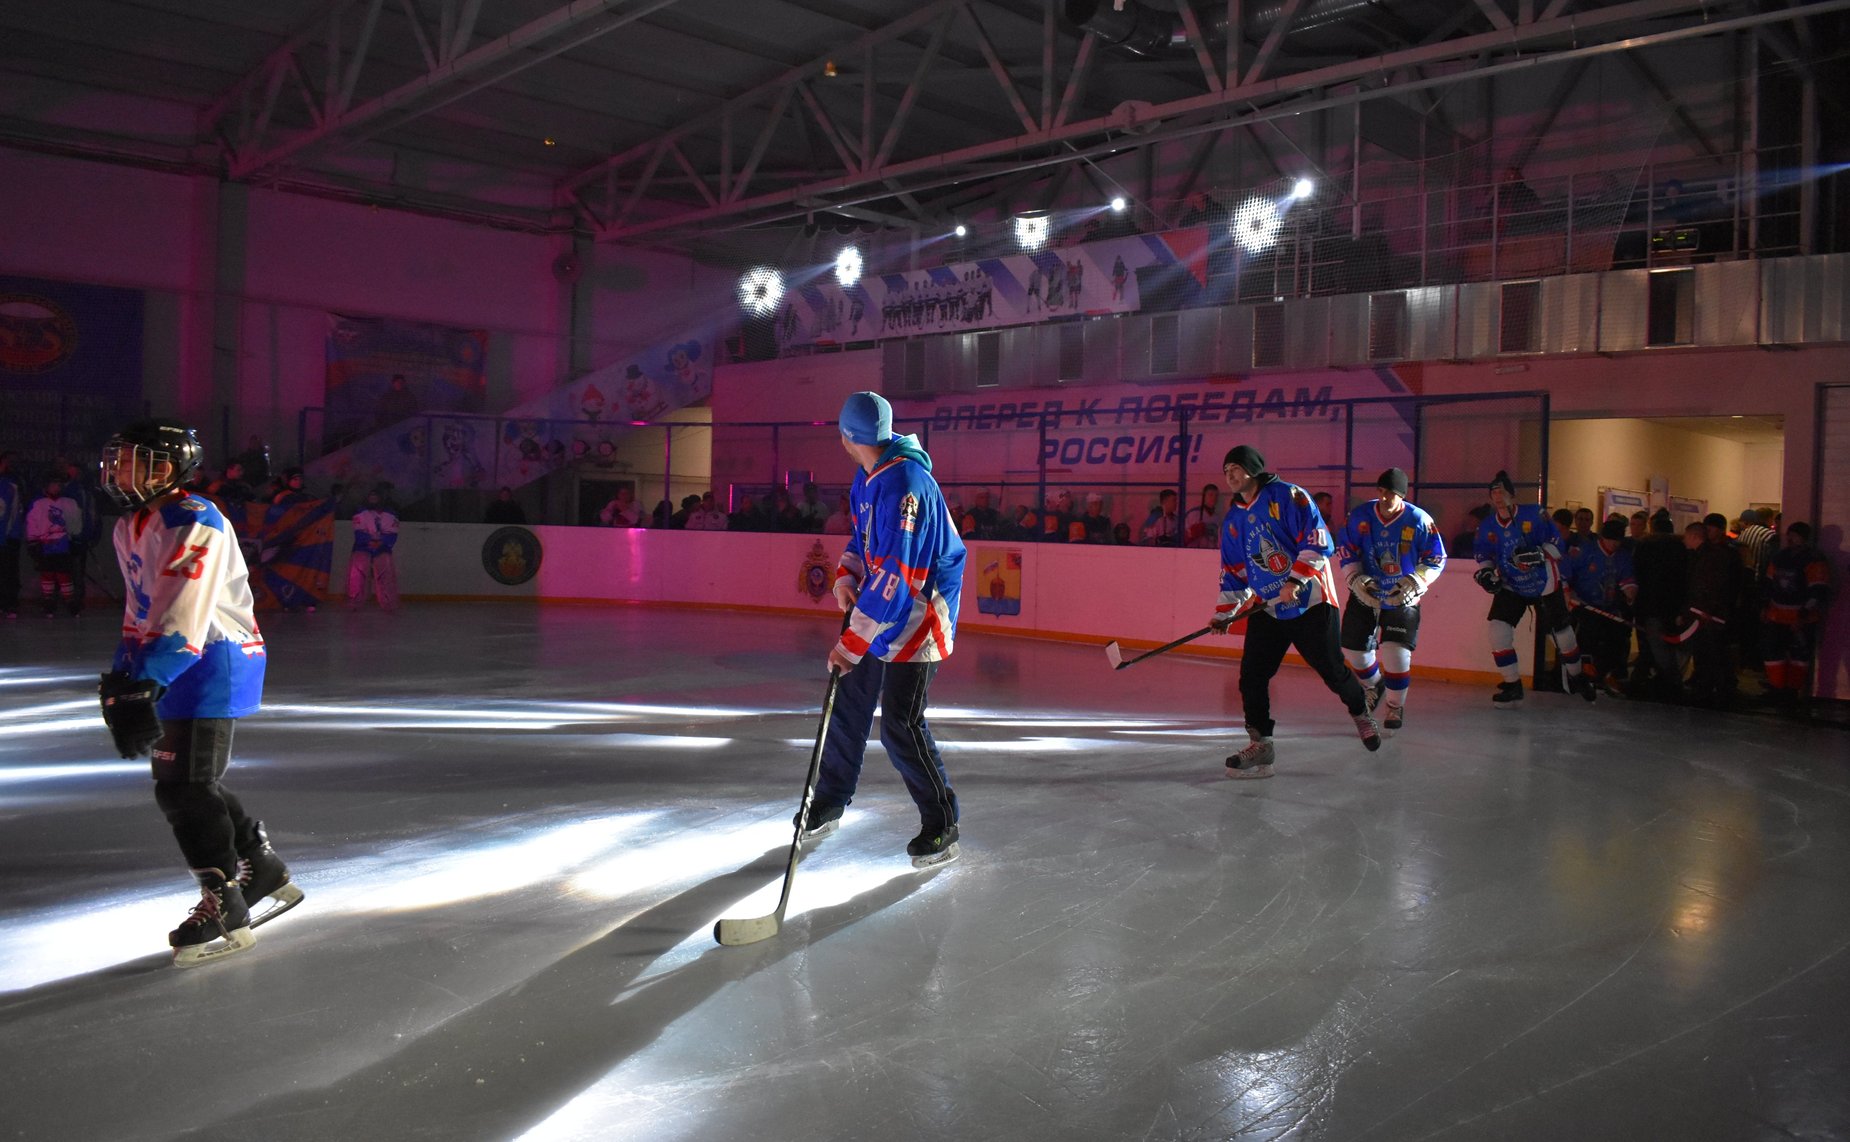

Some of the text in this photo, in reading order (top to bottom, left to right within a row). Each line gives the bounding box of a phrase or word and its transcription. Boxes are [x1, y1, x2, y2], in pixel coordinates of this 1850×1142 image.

[932, 386, 1339, 431] ВПЕРЕД К ПОБЕДАМ,
[1037, 433, 1203, 465] РОССИЯ!
[869, 567, 900, 602] 78
